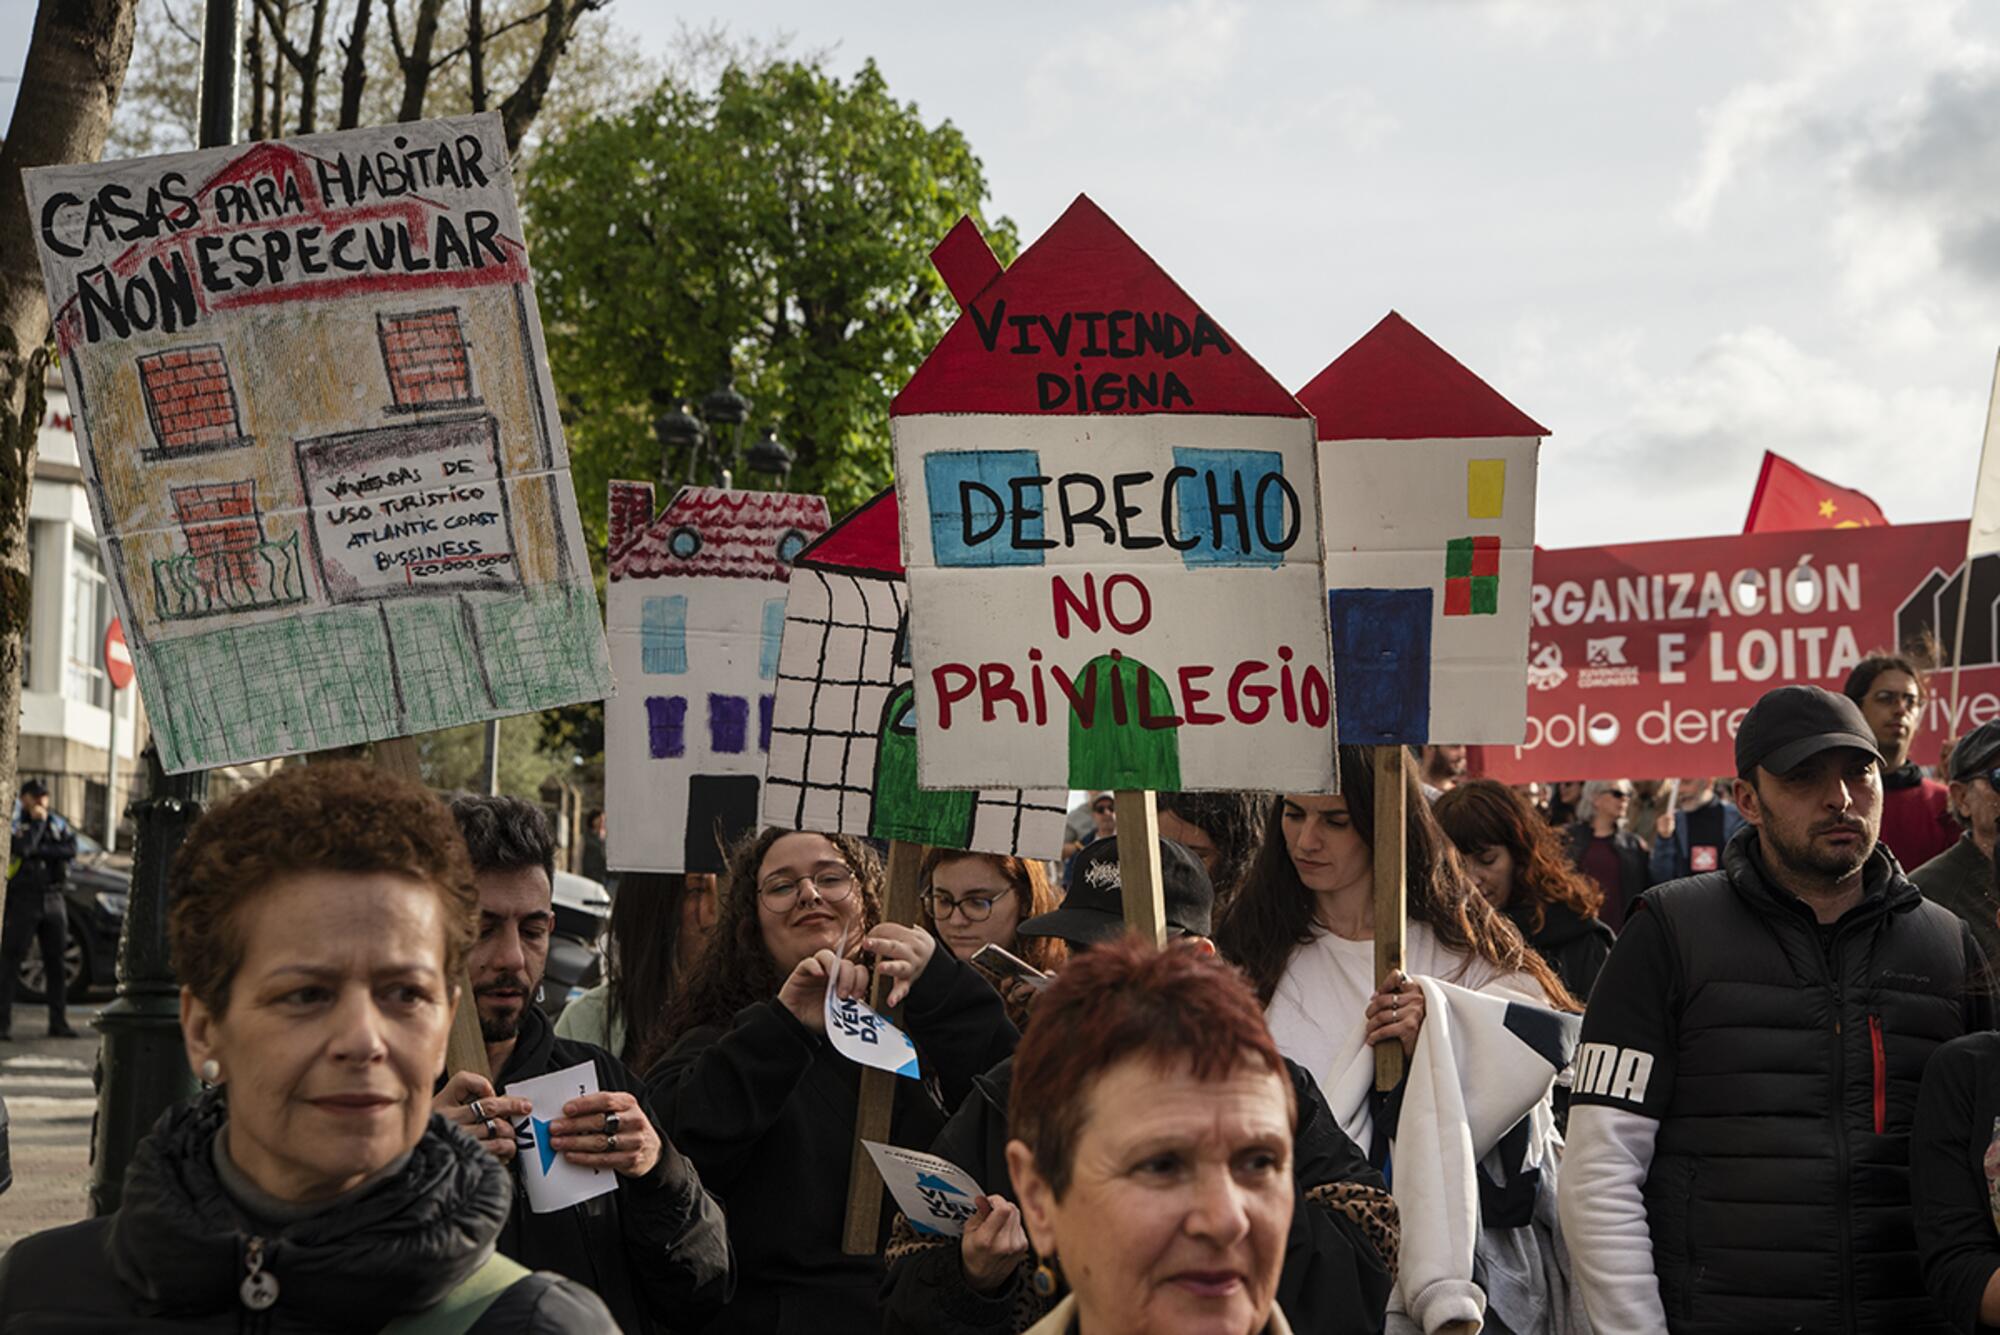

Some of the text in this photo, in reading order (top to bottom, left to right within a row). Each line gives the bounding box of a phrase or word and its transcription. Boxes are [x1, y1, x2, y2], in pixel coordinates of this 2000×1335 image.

[41, 171, 200, 258] CASAS
[215, 175, 304, 224] PARA
[77, 211, 507, 343] NON ESPECULAR
[969, 299, 1232, 359] VIVIENDA
[442, 459, 475, 477] DE
[327, 506, 373, 526] USO
[444, 512, 499, 530] COAST
[959, 467, 1301, 554] DERECHO
[376, 540, 483, 571] BUSSINESS
[1052, 572, 1152, 639] NO
[1530, 553, 1861, 627] RGANIZACIÓN
[1658, 626, 1860, 685] E LOITA
[1515, 703, 1620, 760] polo
[1636, 700, 1751, 745] dere
[860, 1014, 879, 1045] DA
[1571, 1043, 1655, 1104] MA
